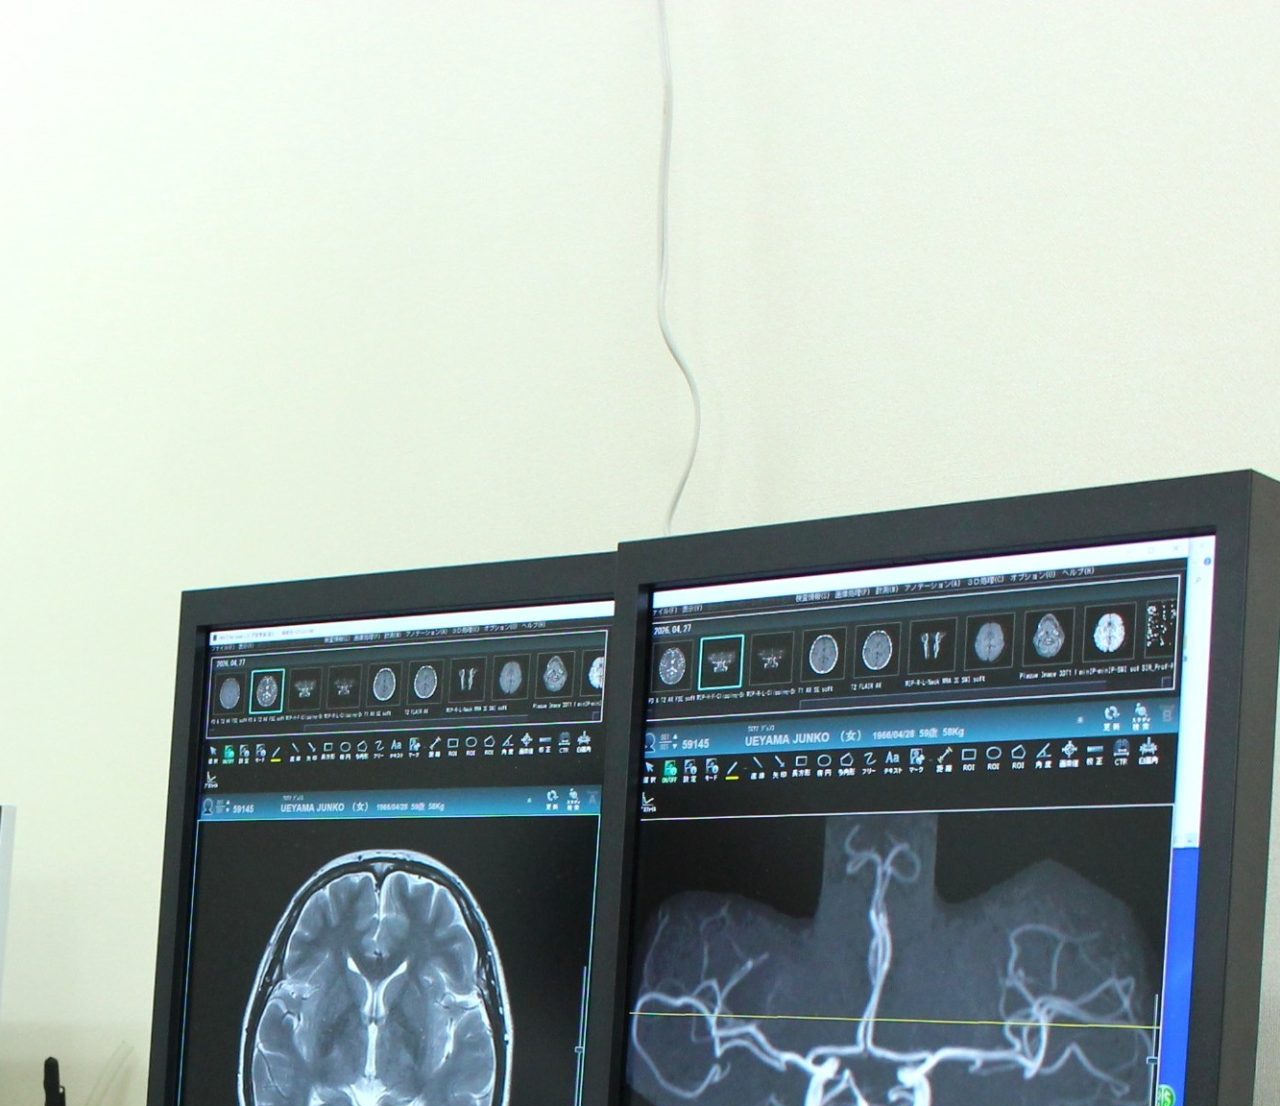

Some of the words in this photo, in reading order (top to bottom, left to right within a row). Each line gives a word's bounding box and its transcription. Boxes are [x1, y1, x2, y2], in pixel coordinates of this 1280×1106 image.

[681, 738, 710, 750] 59145
[745, 733, 790, 747] UEYAMA
[792, 731, 830, 745] JUNKO
[281, 803, 315, 813] UEYAMA
[316, 802, 345, 812] JUNKO
